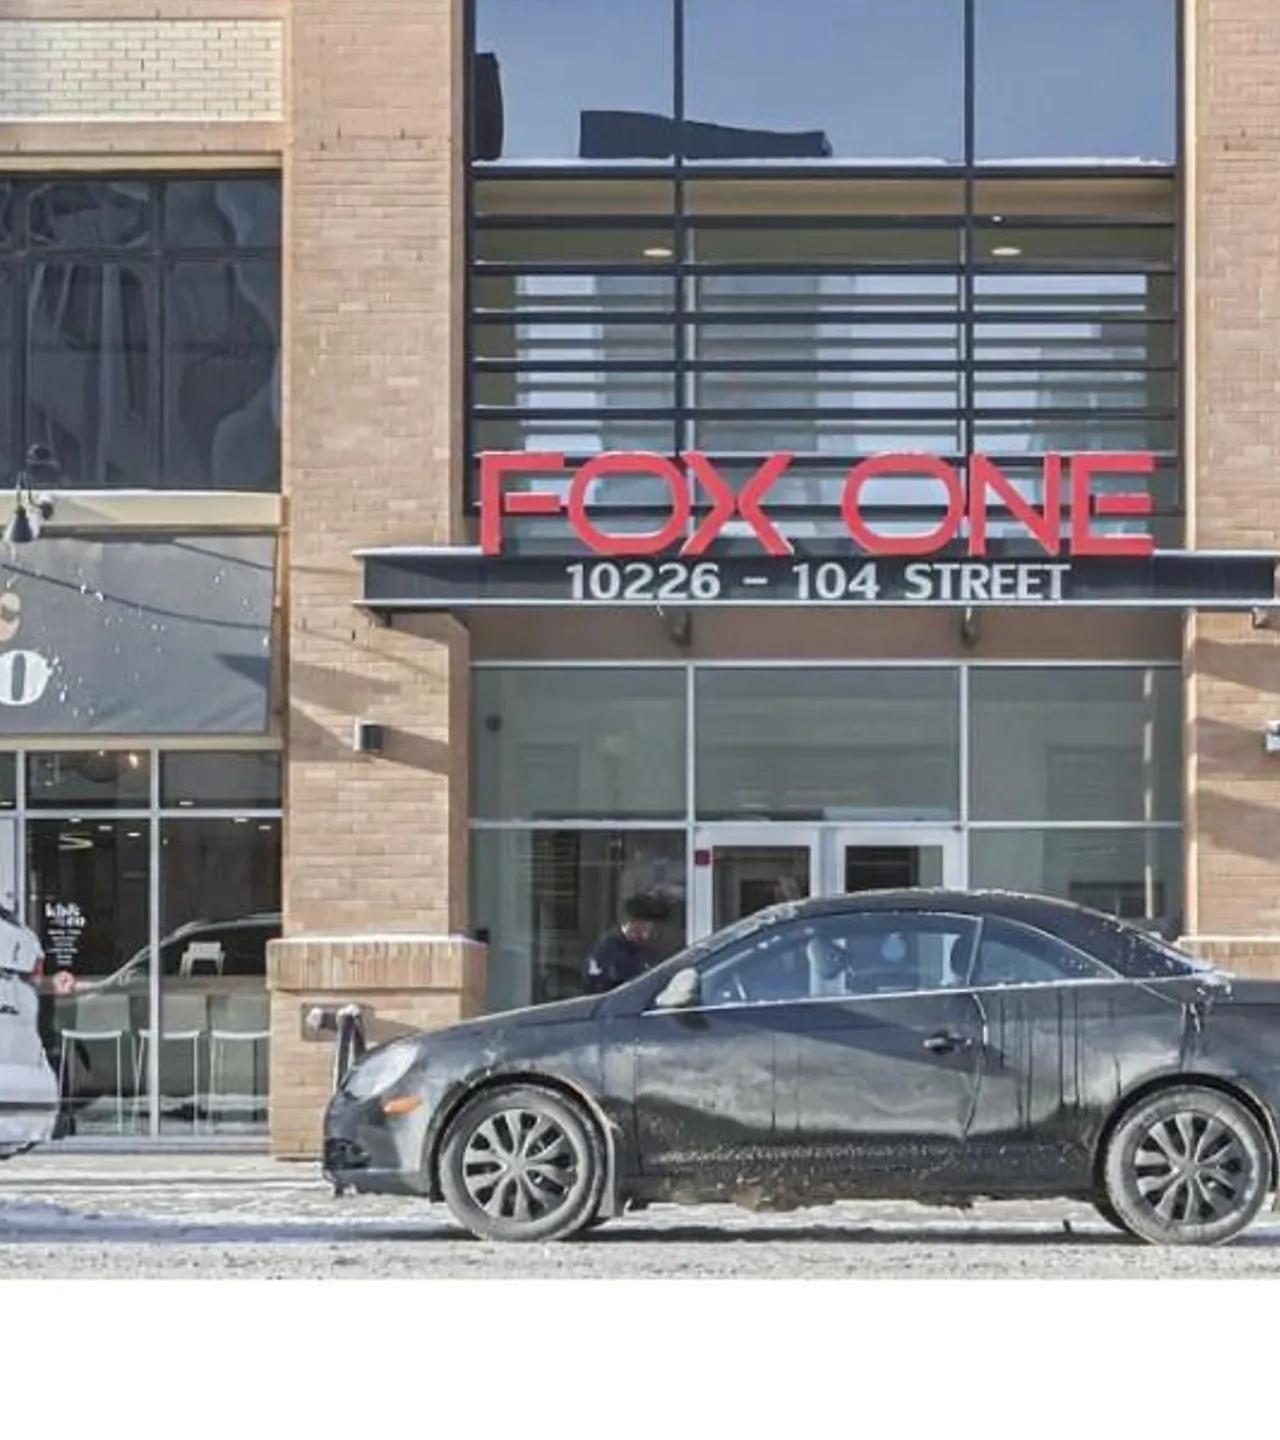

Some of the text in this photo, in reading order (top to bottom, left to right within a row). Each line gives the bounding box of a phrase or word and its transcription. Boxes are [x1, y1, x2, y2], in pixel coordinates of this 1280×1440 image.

[476, 451, 1156, 556] FOX ONE
[566, 563, 721, 601] 10226
[791, 563, 879, 601] 104
[904, 563, 1071, 601] STREET
